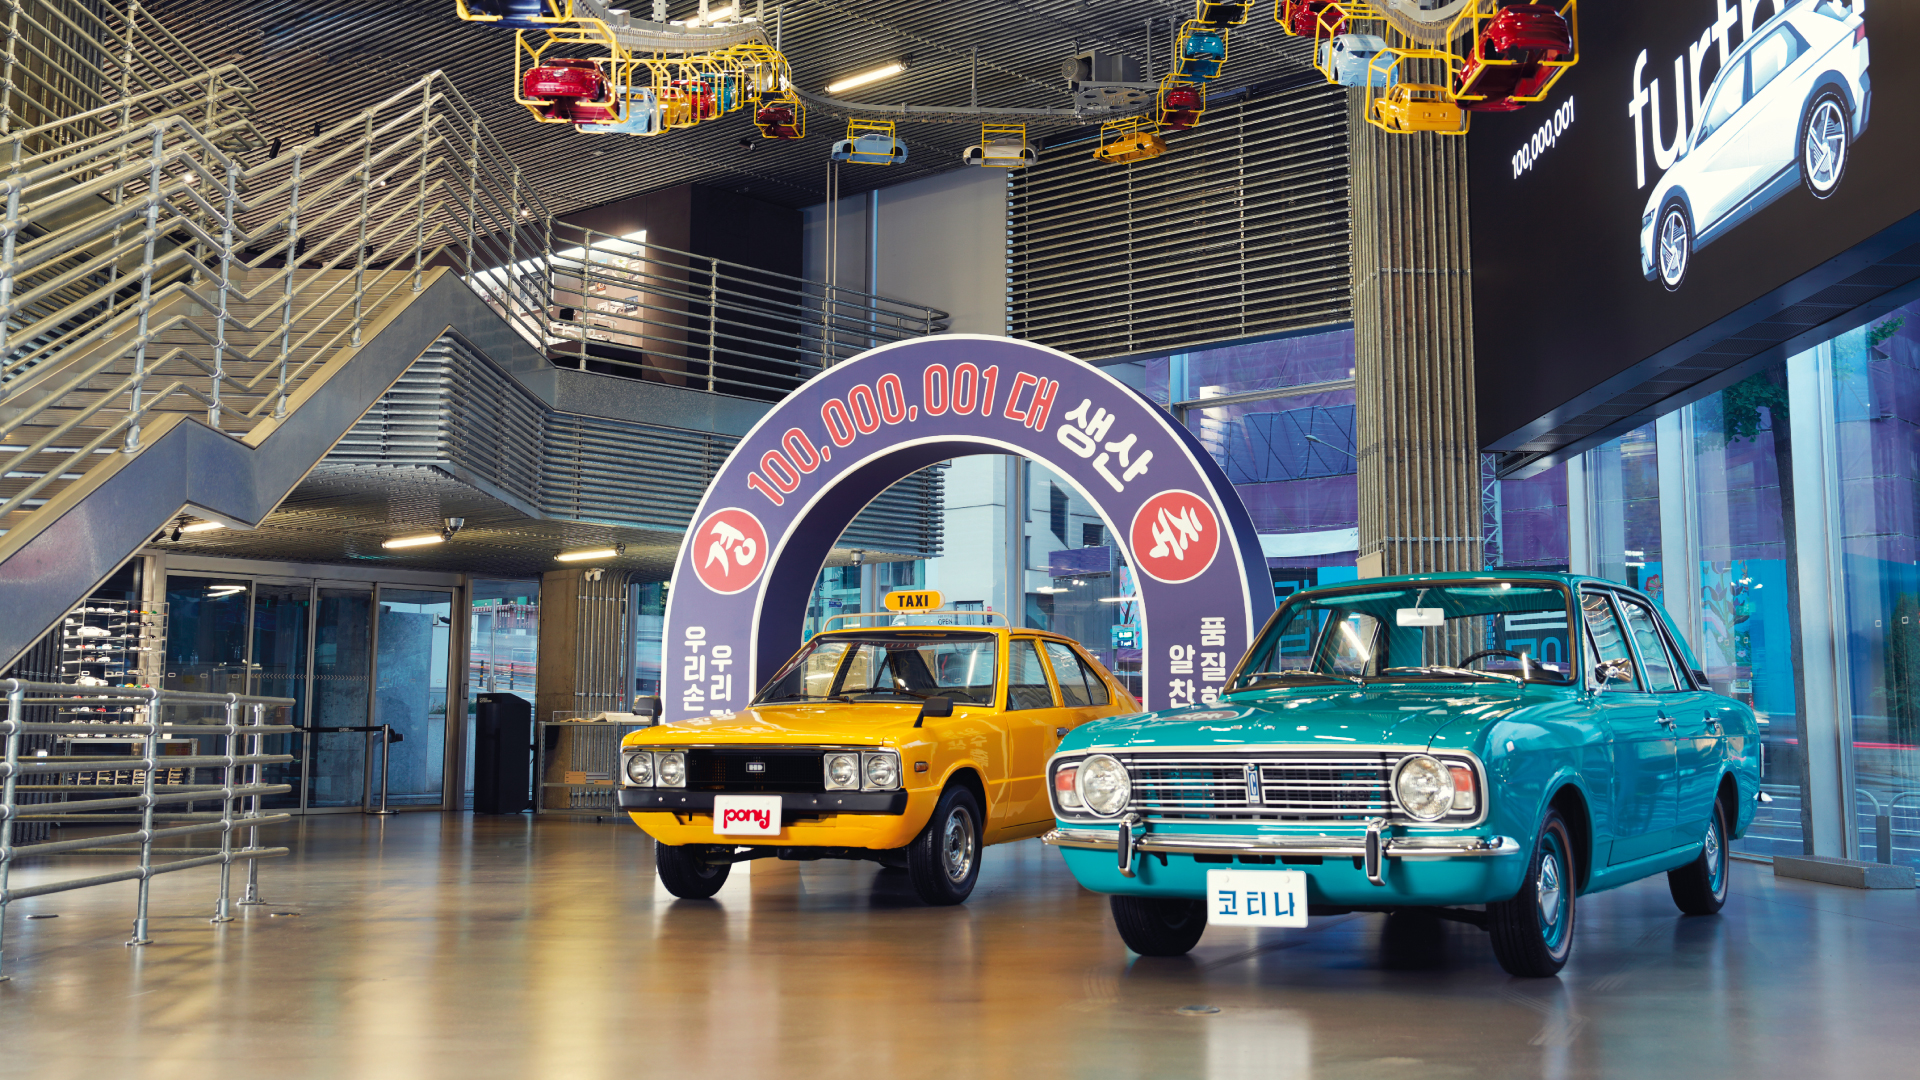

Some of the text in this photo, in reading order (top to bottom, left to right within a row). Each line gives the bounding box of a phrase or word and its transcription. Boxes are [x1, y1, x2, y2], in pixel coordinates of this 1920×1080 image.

[1511, 95, 1574, 180] 100,000,001
[747, 362, 1154, 507] 100,000,001 대 생산
[704, 520, 757, 578] 경
[1148, 505, 1203, 561] 축
[897, 594, 929, 608] TAXI
[710, 645, 732, 701] 우리
[1169, 644, 1196, 709] 알찬
[723, 809, 770, 829] pony
[1218, 890, 1295, 917] 코티나
